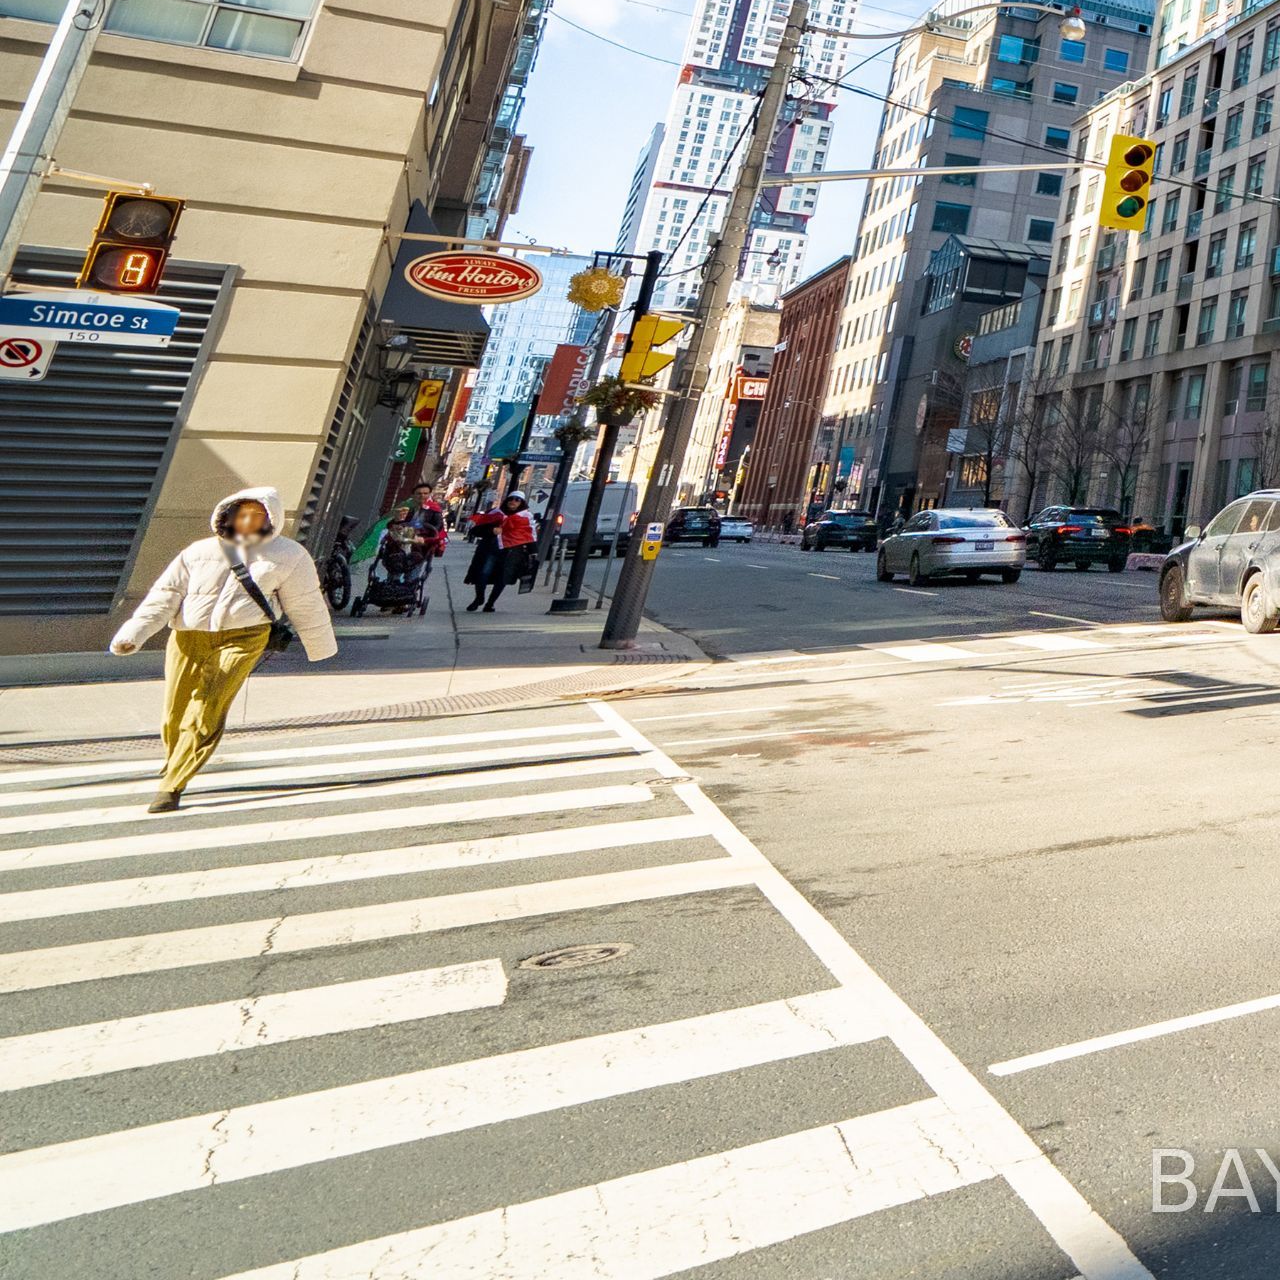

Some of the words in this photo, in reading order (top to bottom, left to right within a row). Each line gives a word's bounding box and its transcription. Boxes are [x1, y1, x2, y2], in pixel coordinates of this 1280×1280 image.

[463, 259, 497, 267] ALWAYS
[416, 263, 453, 282] Tim
[457, 265, 535, 289] Hortons
[29, 305, 125, 328] Simcoe
[130, 316, 149, 330] St
[68, 331, 100, 342] 150
[724, 403, 737, 432] DIAL
